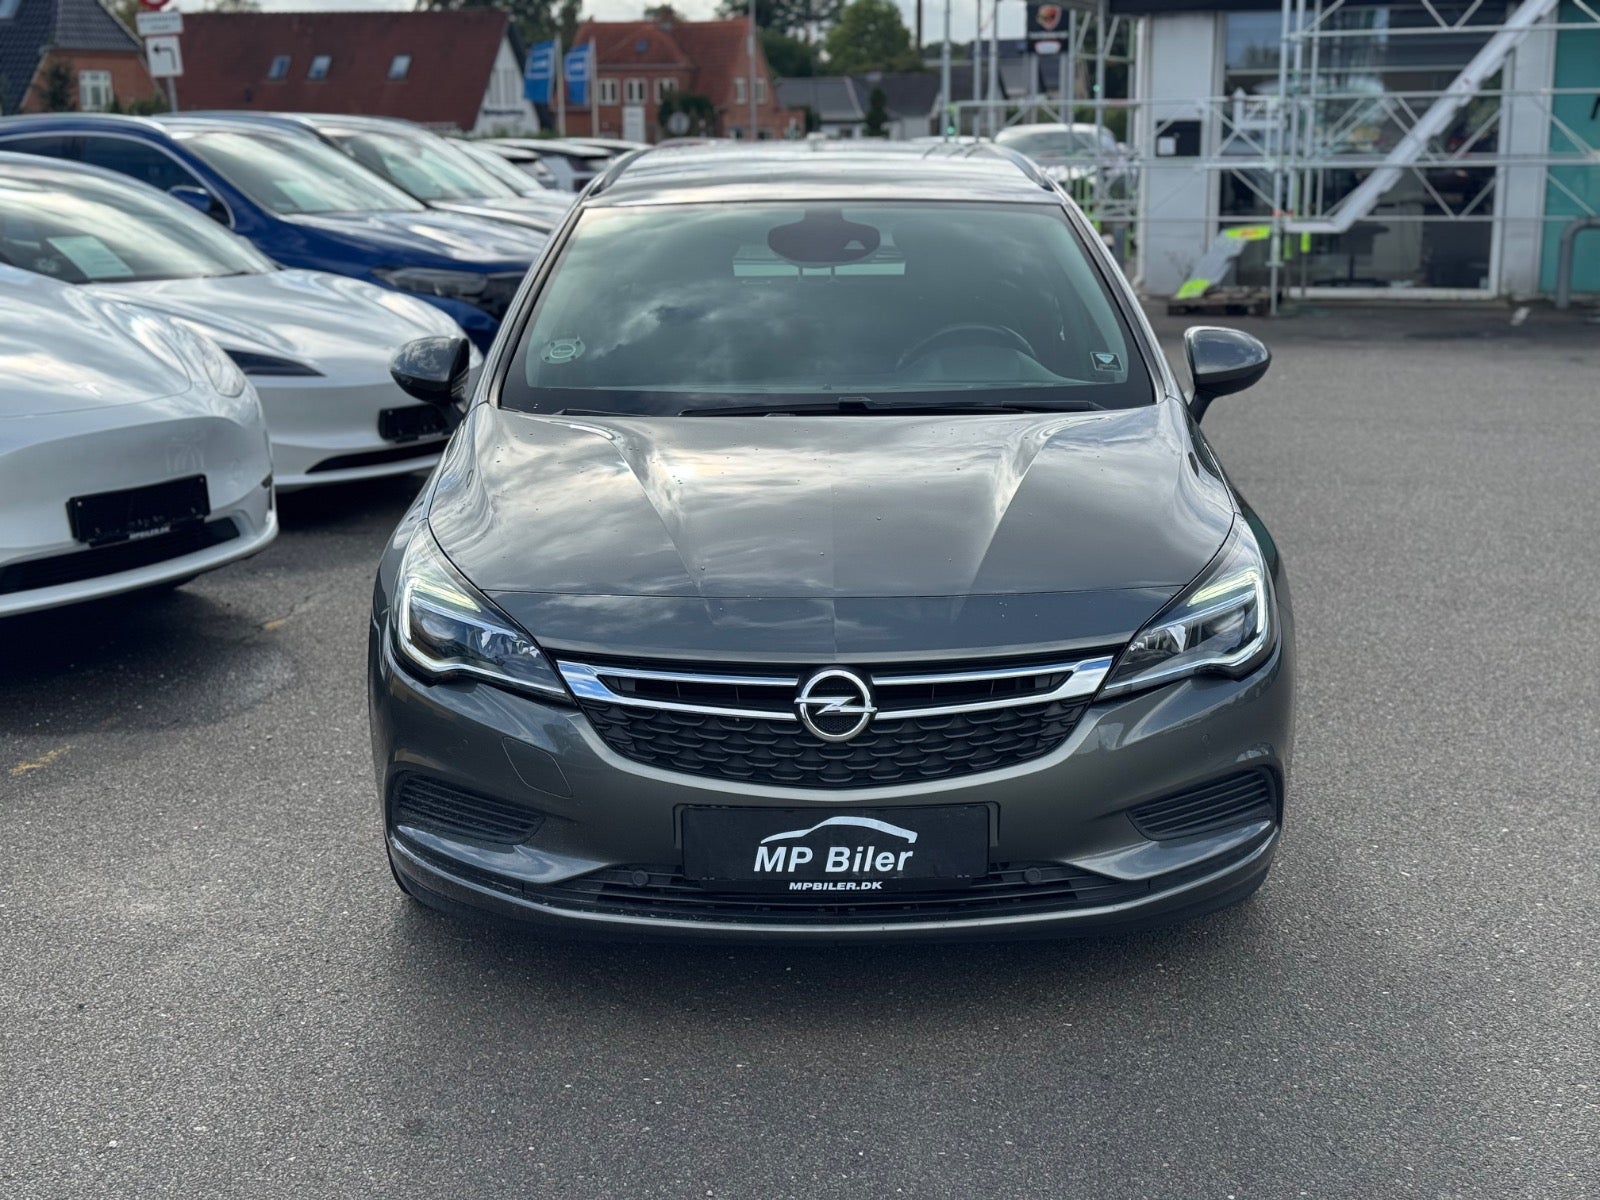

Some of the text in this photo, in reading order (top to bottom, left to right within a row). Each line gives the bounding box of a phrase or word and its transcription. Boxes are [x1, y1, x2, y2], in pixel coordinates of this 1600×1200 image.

[753, 845, 913, 873] MP Biler
[789, 881, 883, 891] MPBILER.DK
